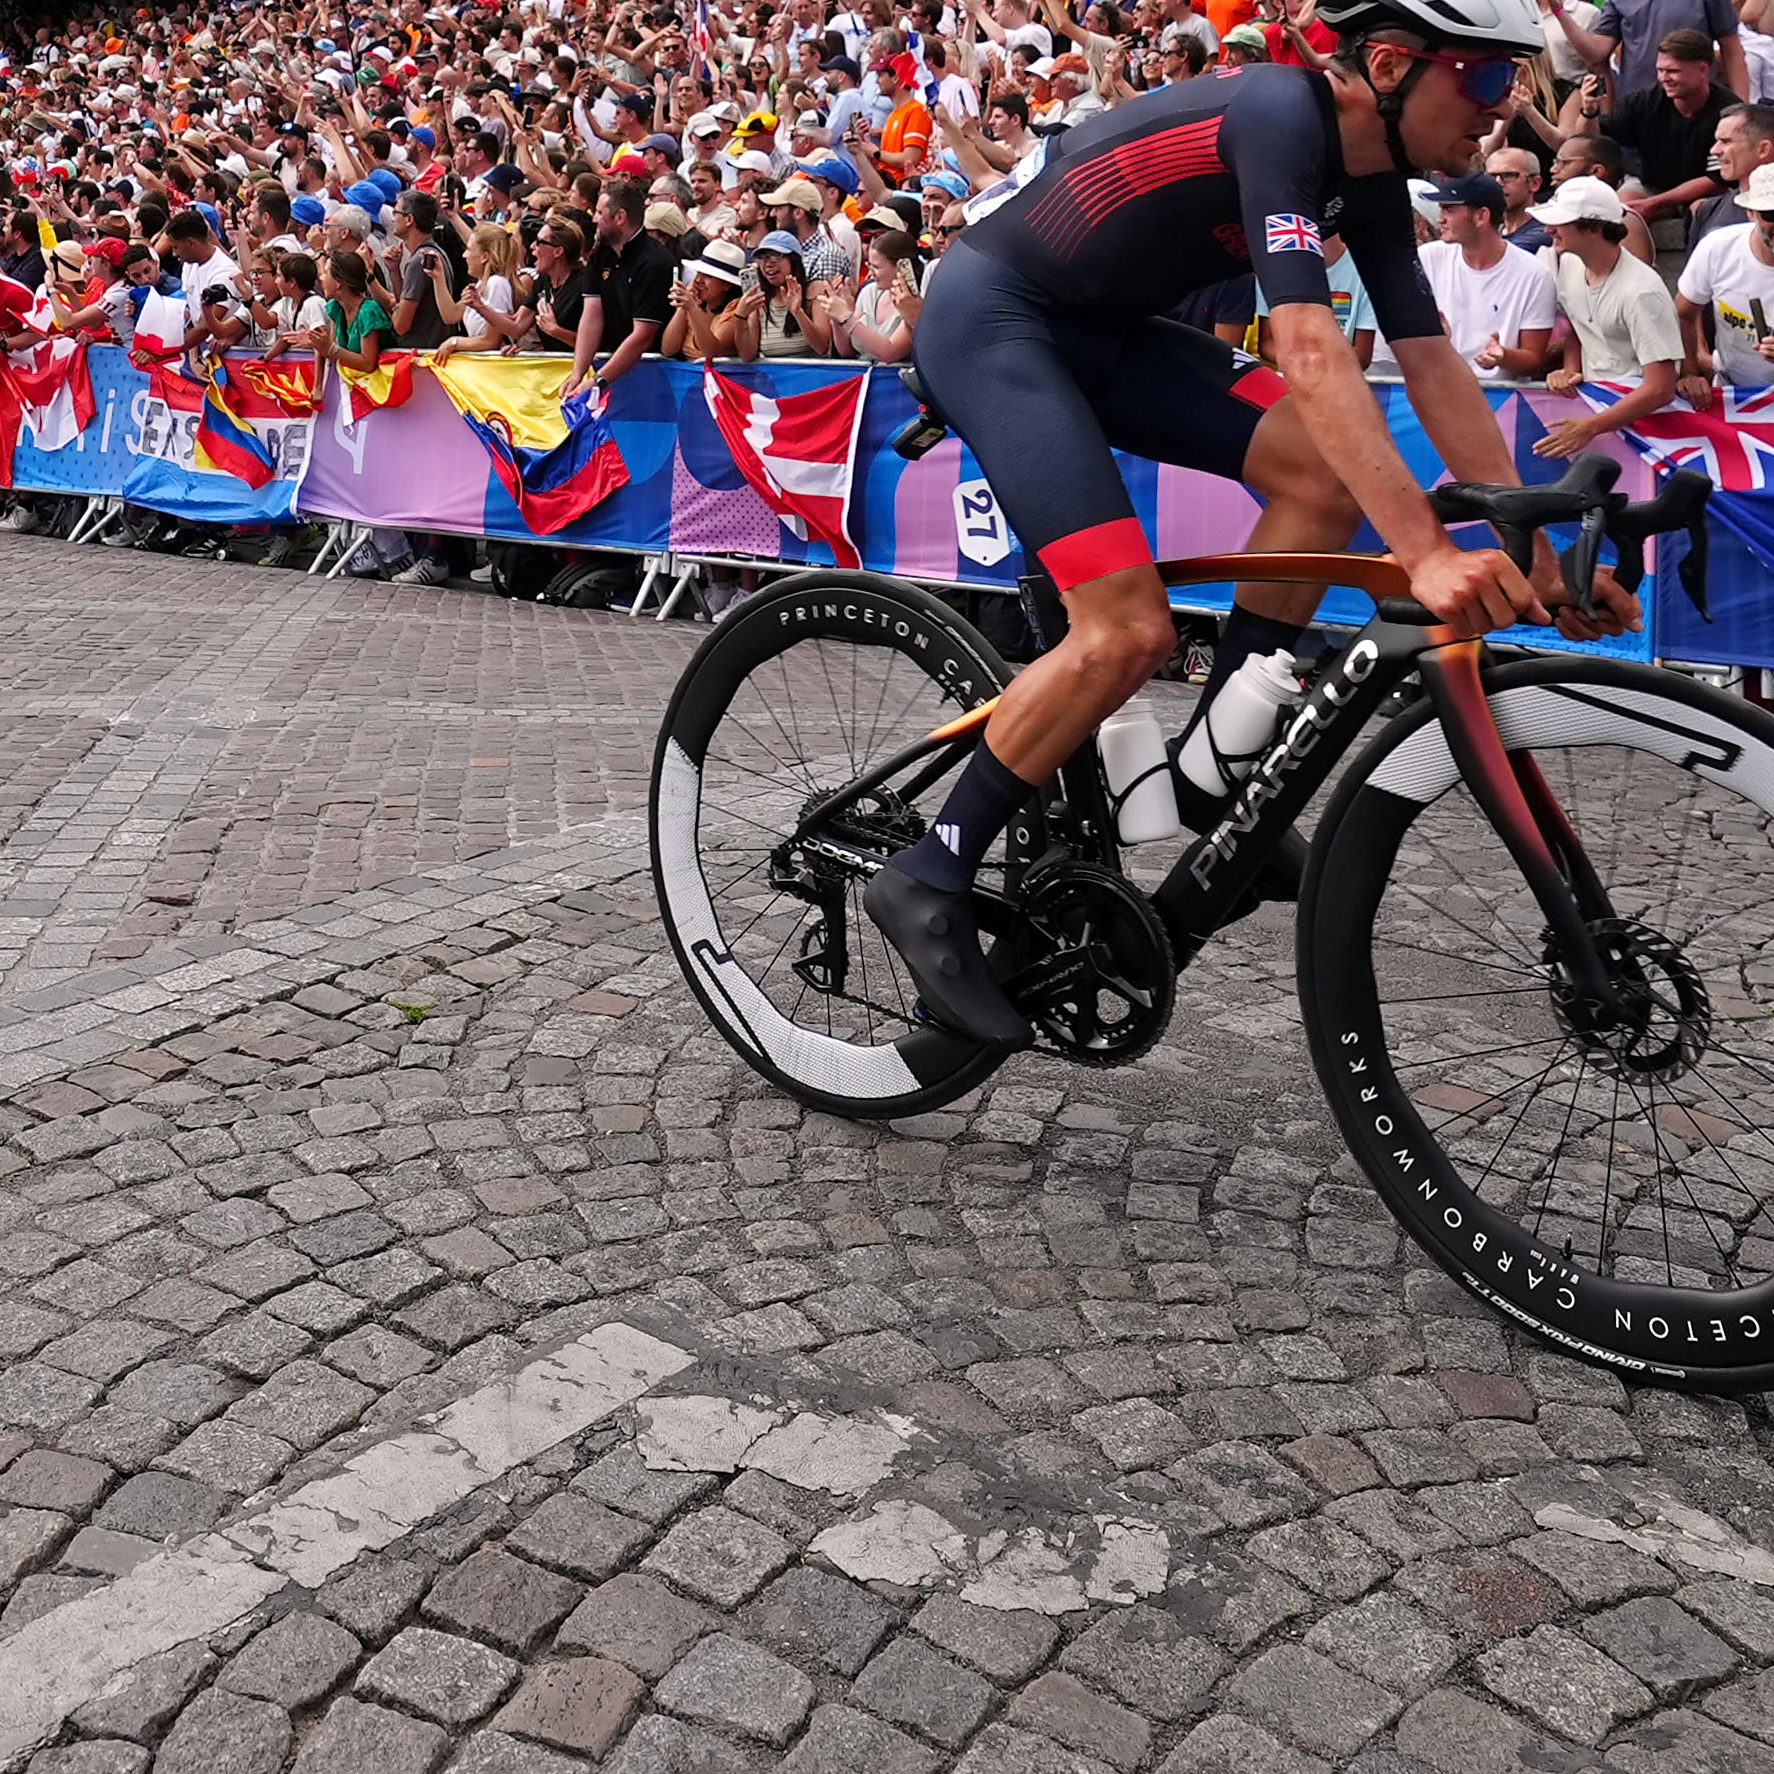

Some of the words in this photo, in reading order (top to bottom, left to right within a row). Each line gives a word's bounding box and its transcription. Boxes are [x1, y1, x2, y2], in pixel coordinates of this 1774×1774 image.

[962, 489, 998, 540] 27
[779, 603, 930, 651] PRINCETON
[1189, 638, 1379, 892] PINARELLO
[1341, 1031, 1576, 1310] CARBONWORKS
[1489, 1295, 1541, 1329] 5000
[1539, 1325, 1582, 1349] PRIX
[1581, 1345, 1646, 1371] GRAND
